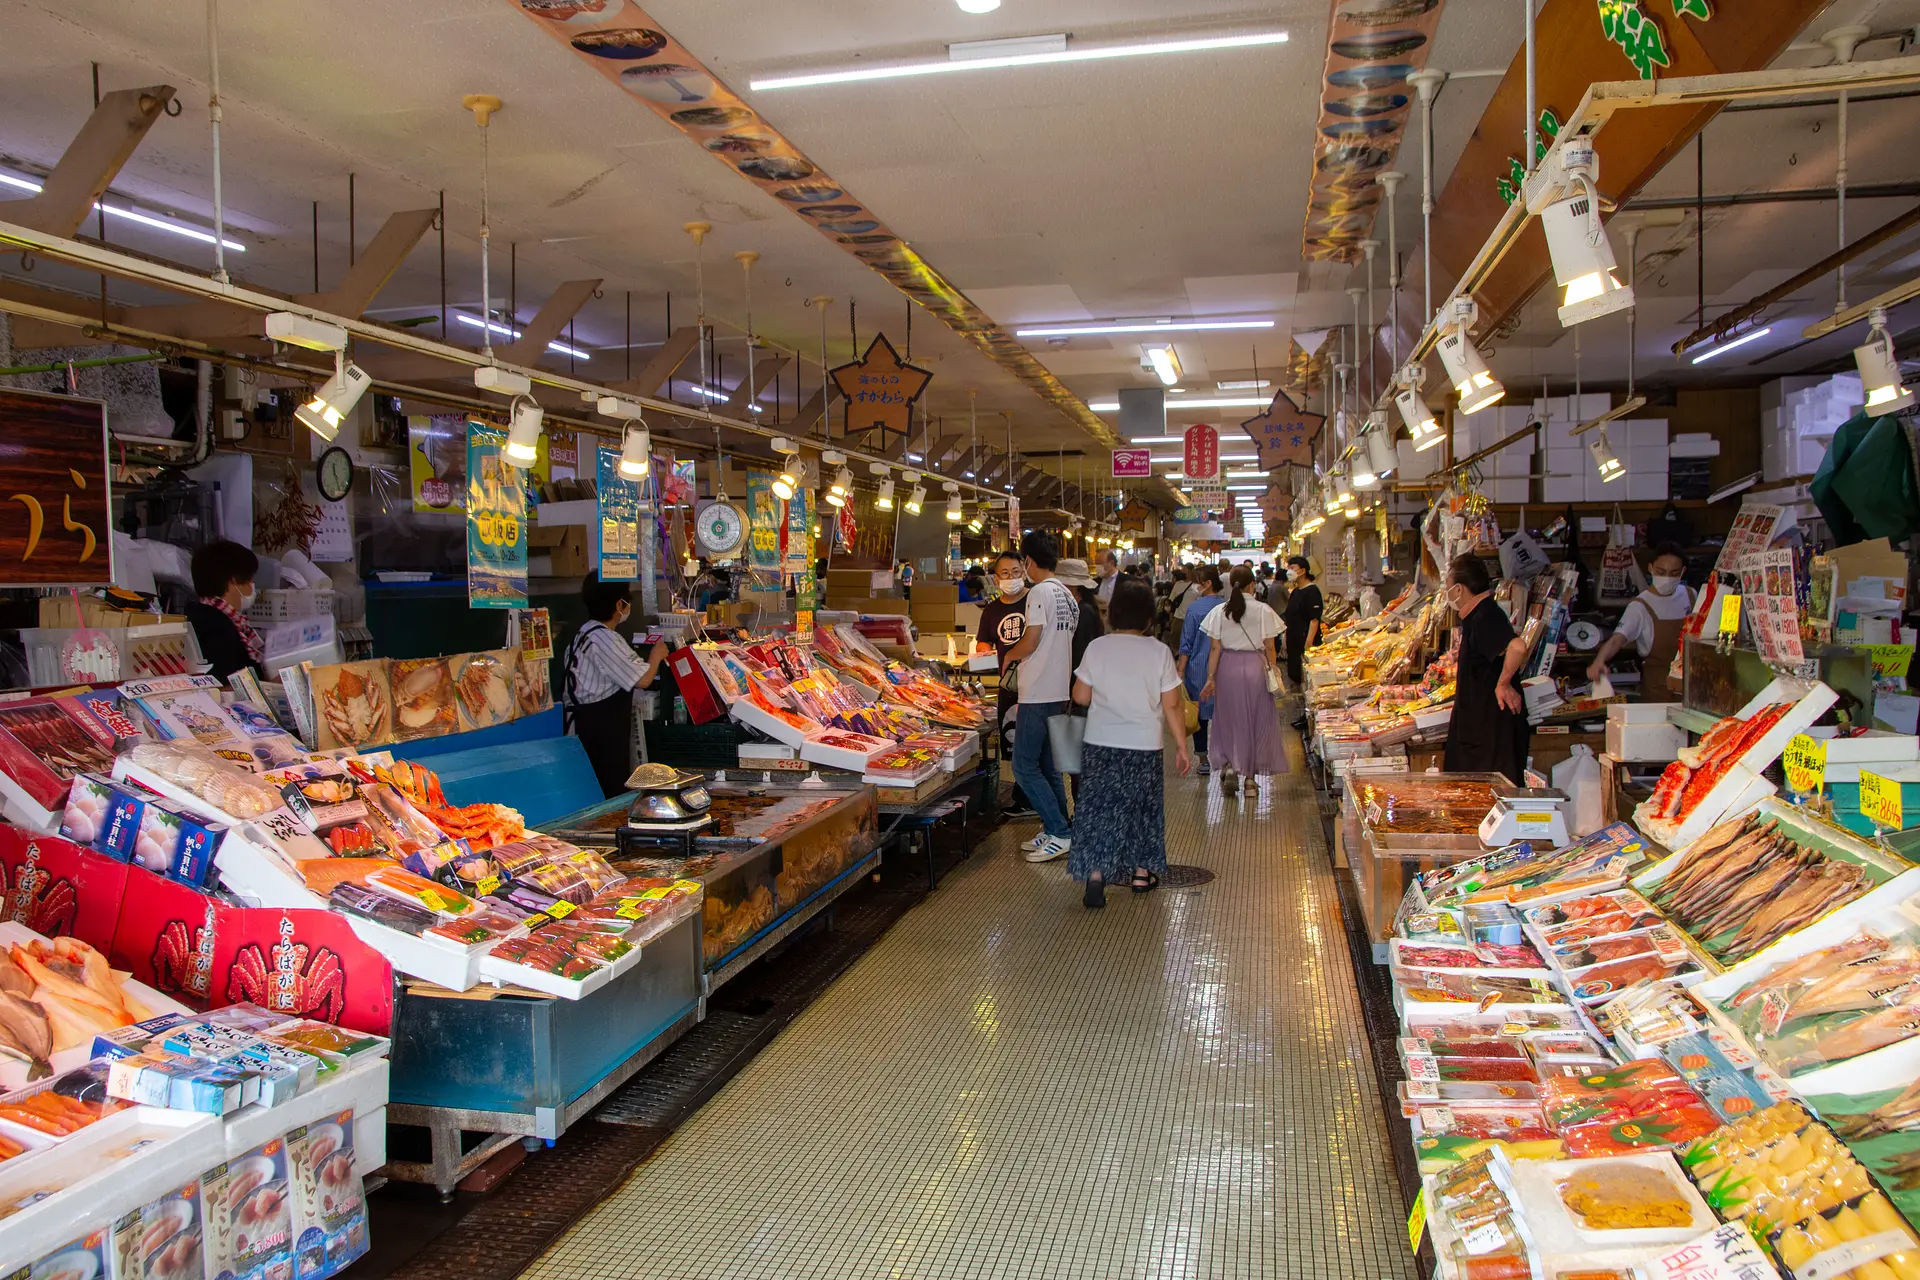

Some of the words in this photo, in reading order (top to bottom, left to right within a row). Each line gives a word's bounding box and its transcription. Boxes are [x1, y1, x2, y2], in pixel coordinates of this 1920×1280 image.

[858, 375, 900, 385] 海のもの
[856, 390, 904, 404] すがわら
[1264, 422, 1305, 434] 珍味食品
[1269, 436, 1303, 450] 鈴木
[481, 516, 517, 541] 取扱店
[1003, 619, 1013, 638] 朝市
[87, 698, 144, 739] 紅鮭
[107, 806, 125, 847] 帆立貝柱
[178, 836, 196, 877] 帆立貝柱
[12, 844, 40, 926] たらばがに
[278, 918, 295, 1009] たらばがに
